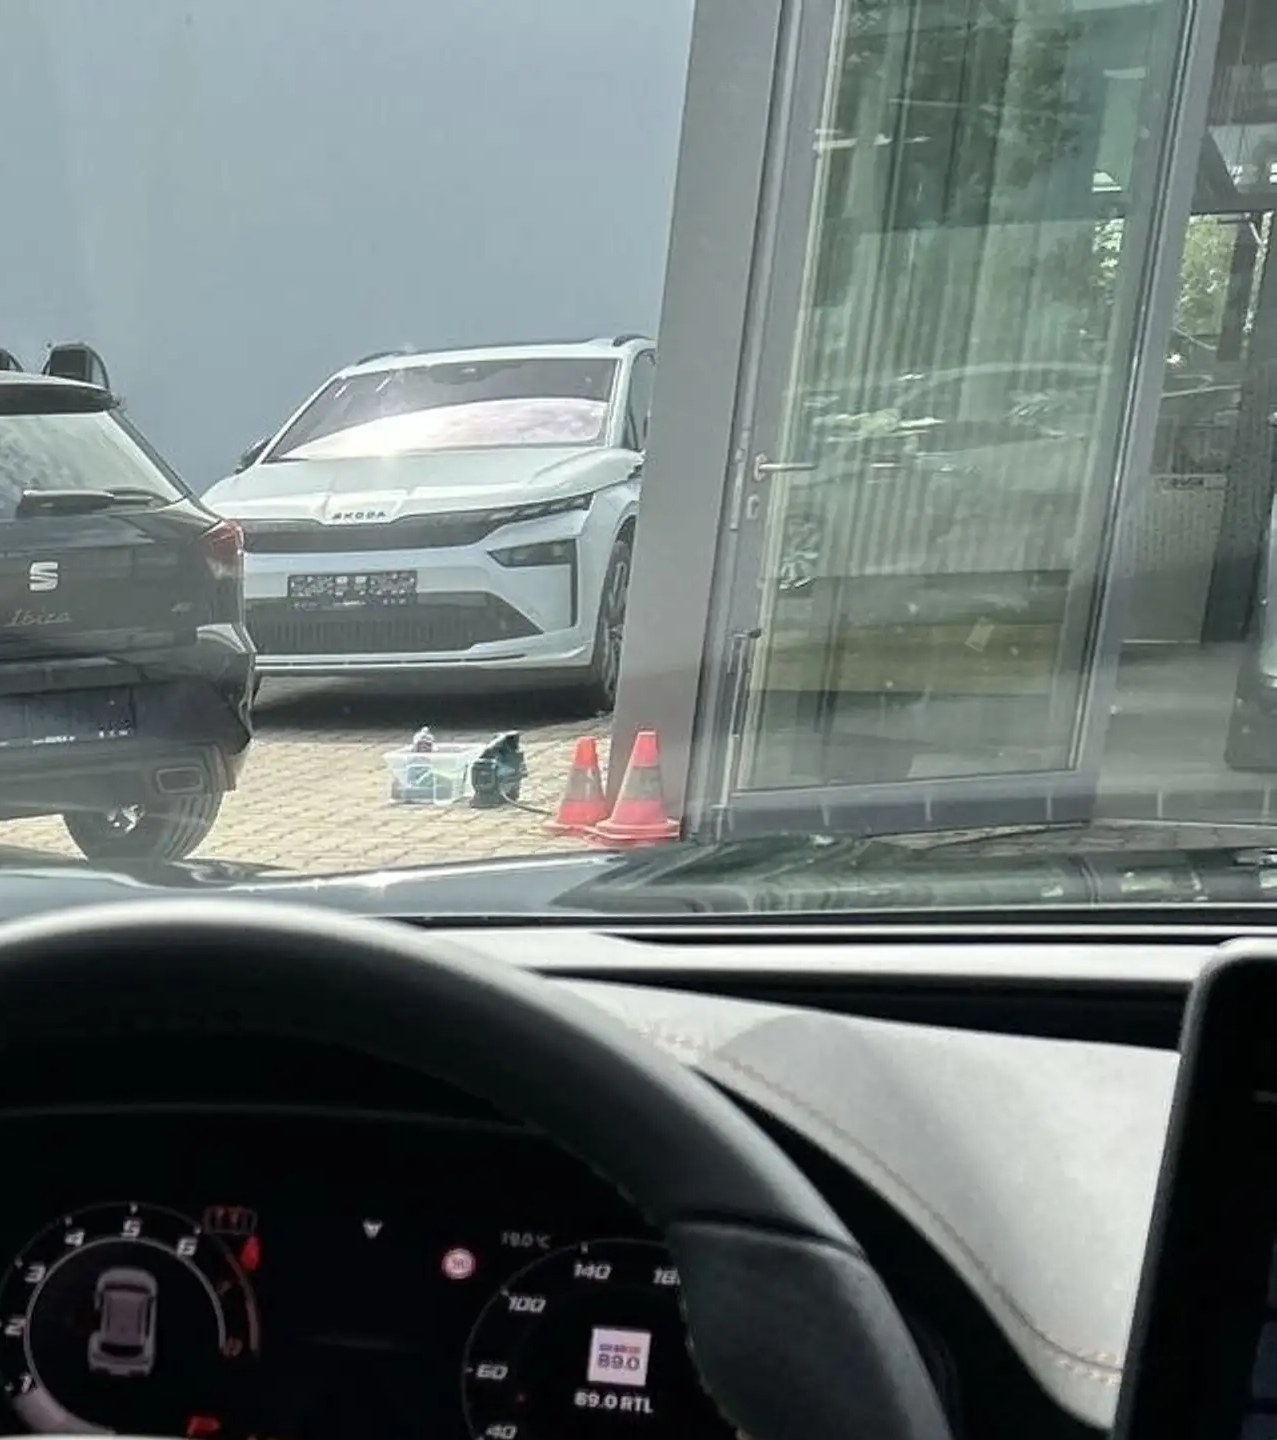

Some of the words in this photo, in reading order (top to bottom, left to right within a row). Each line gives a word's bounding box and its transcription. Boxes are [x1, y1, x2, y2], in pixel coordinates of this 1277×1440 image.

[64, 1228, 85, 1247] 4
[121, 1218, 141, 1238] 5
[177, 1236, 197, 1257] 6
[24, 1264, 47, 1283] 3
[574, 1260, 611, 1279] 140
[653, 1267, 681, 1285] 18
[508, 1295, 546, 1313] 100
[4, 1316, 27, 1336] 2
[597, 1353, 641, 1371] 89.0
[476, 1364, 508, 1381] 60
[20, 1373, 33, 1393] 1
[619, 1395, 654, 1414] RTL
[486, 1424, 517, 1440] 40
